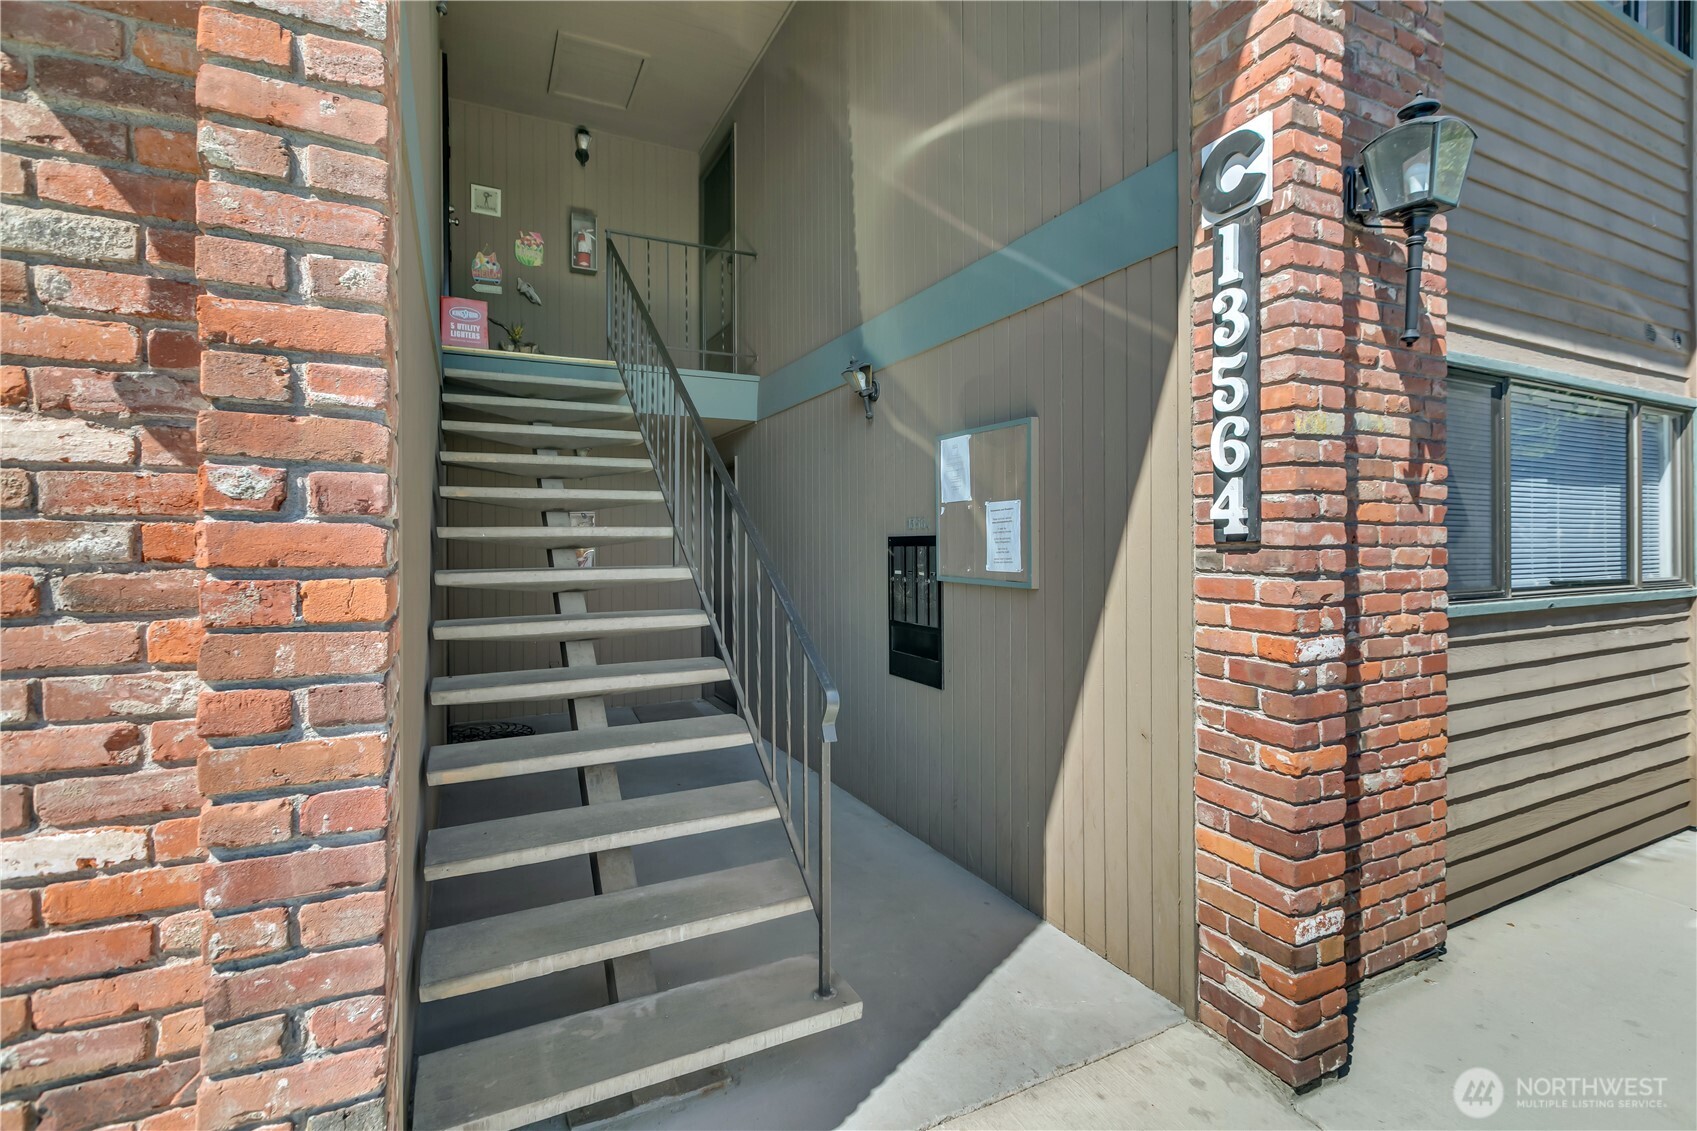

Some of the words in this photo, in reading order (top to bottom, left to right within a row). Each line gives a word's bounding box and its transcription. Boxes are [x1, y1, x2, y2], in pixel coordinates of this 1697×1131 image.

[1200, 129, 1266, 216] C
[450, 330, 481, 340] LIGHTERS
[457, 323, 481, 332] UTILITY
[1209, 222, 1251, 537] 13564
